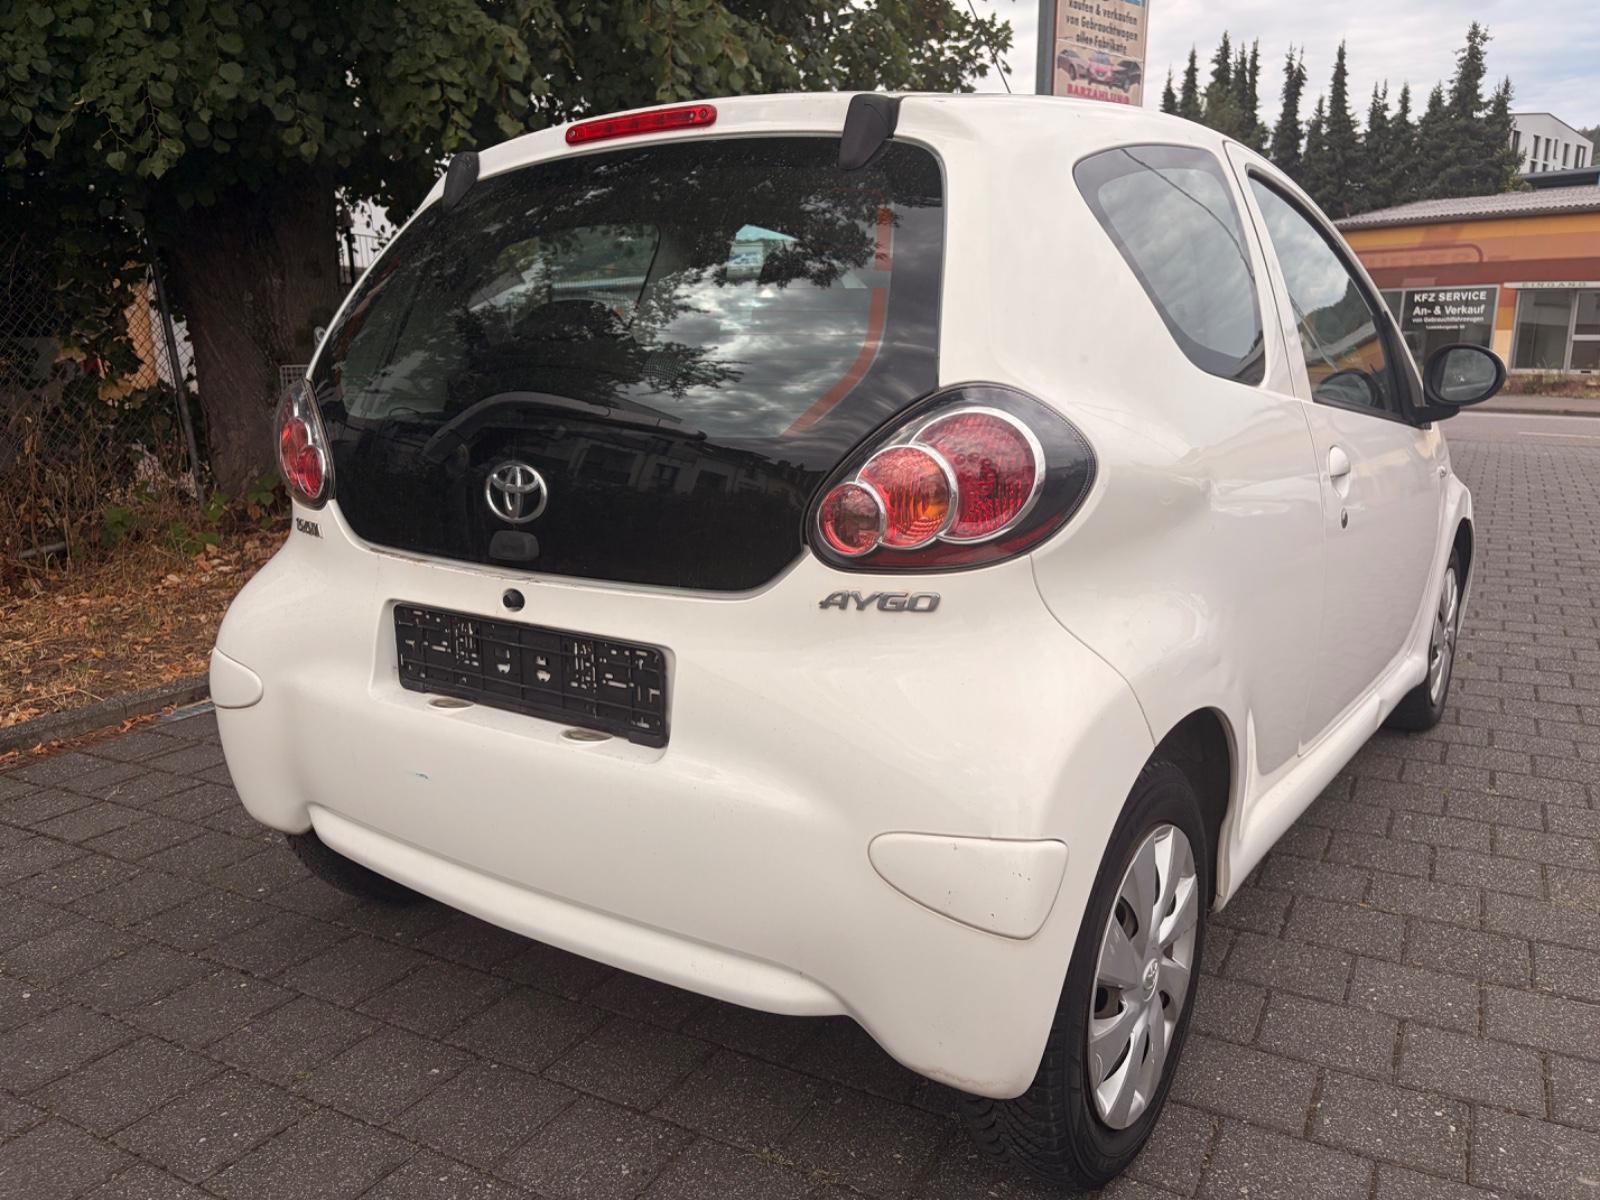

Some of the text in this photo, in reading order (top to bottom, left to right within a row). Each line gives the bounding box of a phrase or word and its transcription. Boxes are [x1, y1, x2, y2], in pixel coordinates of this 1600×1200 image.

[1067, 83, 1130, 105] BARZAHLUNG
[1413, 291, 1488, 303] KFZ SERVICE
[1412, 304, 1486, 316] An- & Verkauf
[818, 590, 941, 613] AYGO
